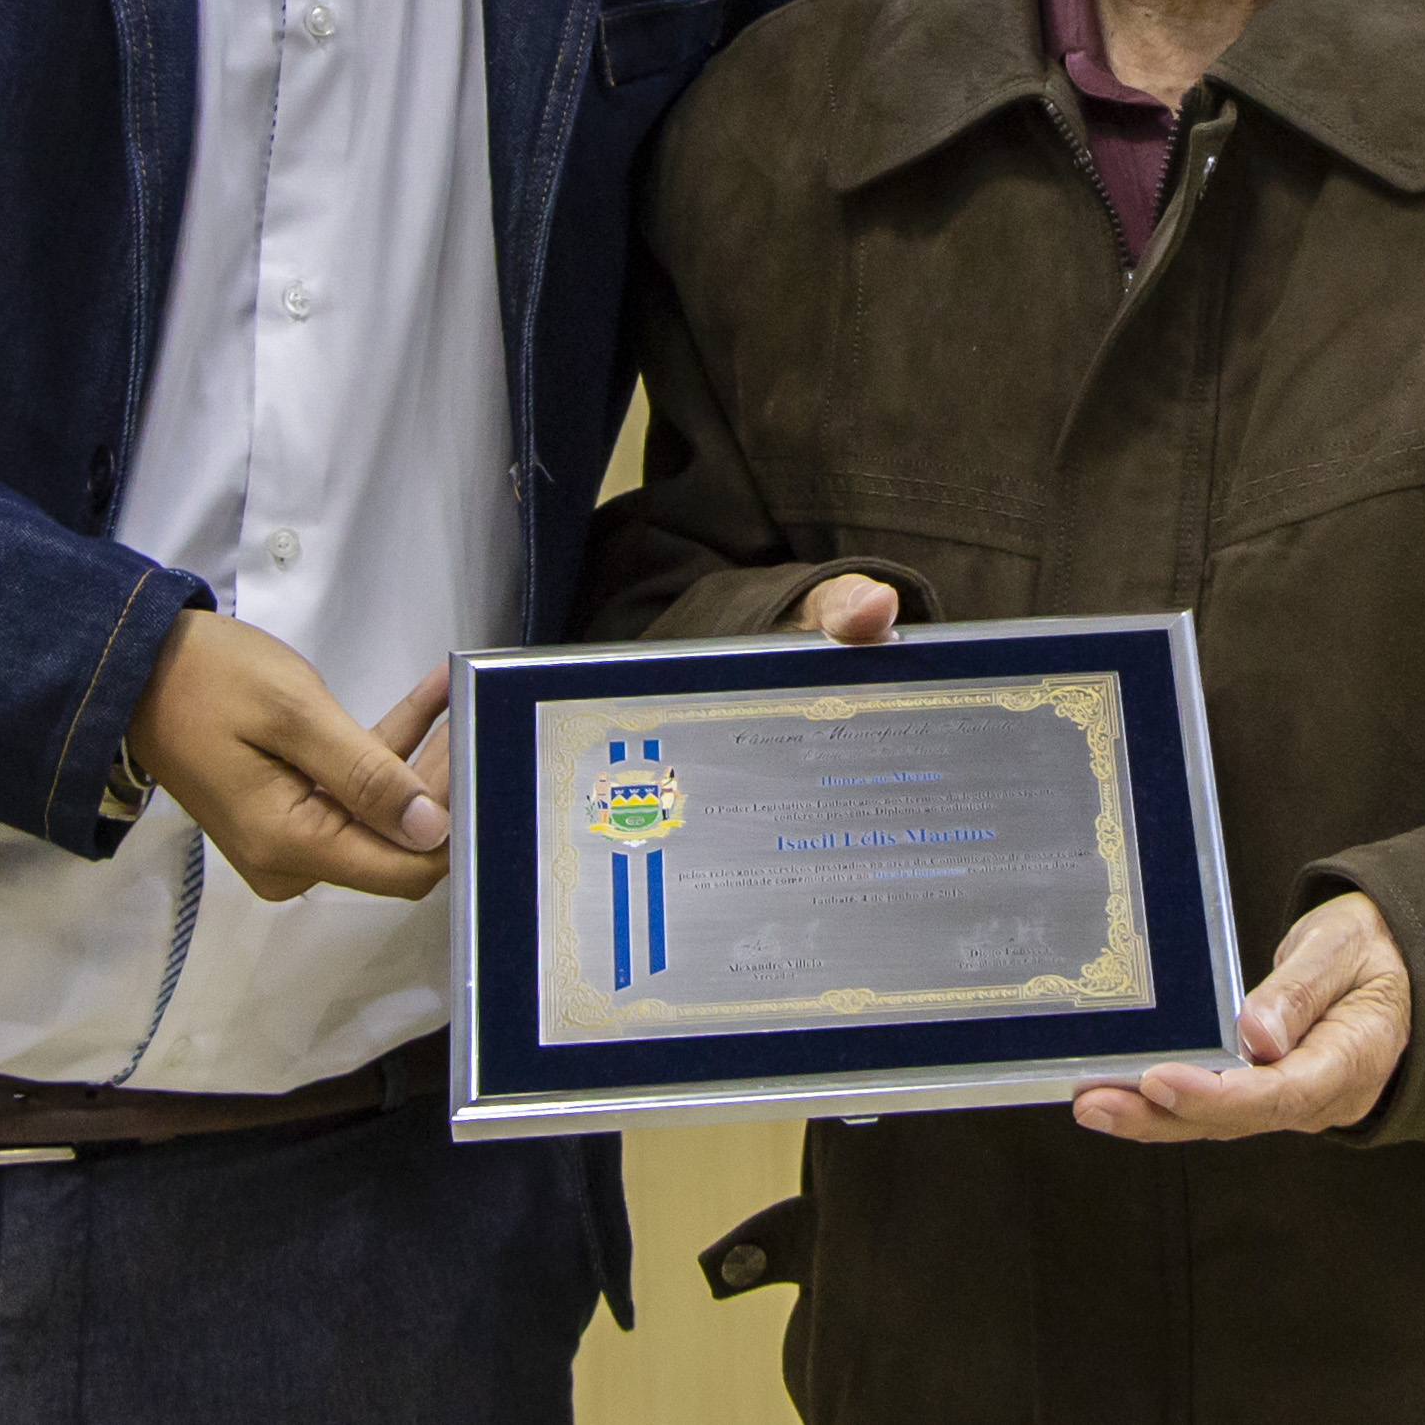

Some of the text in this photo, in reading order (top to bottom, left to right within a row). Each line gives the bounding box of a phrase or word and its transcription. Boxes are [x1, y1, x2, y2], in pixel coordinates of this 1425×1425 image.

[734, 727, 804, 744] Câmara
[704, 806, 714, 814] O
[718, 803, 749, 813] Poder
[753, 800, 813, 813] Legislativo
[774, 811, 814, 822] confere
[874, 806, 921, 817] Diploma
[778, 826, 995, 851] Isacil Lélis Martins
[678, 870, 707, 882] pelos
[710, 868, 766, 878] relevantes
[694, 882, 710, 890] em
[714, 877, 772, 888] solenidade
[728, 961, 783, 973] Alexandre
